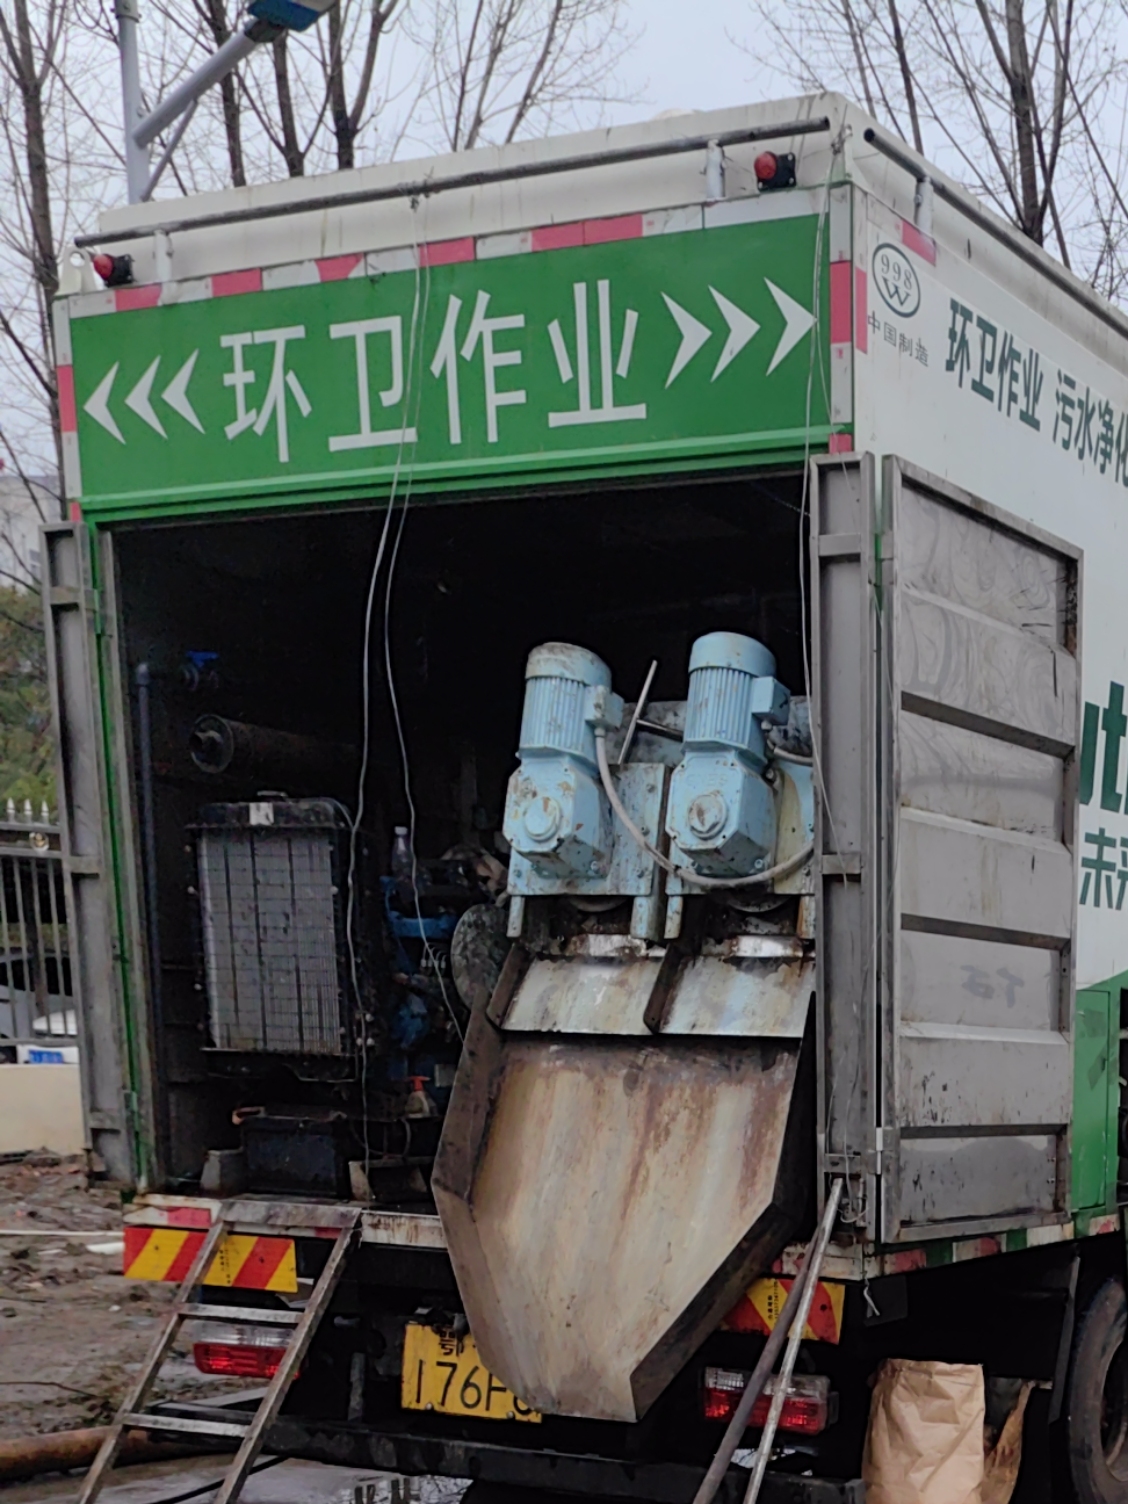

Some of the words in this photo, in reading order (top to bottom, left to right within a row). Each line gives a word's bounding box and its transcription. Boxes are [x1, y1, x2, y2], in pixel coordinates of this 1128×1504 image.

[221, 278, 647, 463] 环卫作业
[867, 310, 929, 367] 中国制造
[945, 297, 1044, 432] 环卫作业
